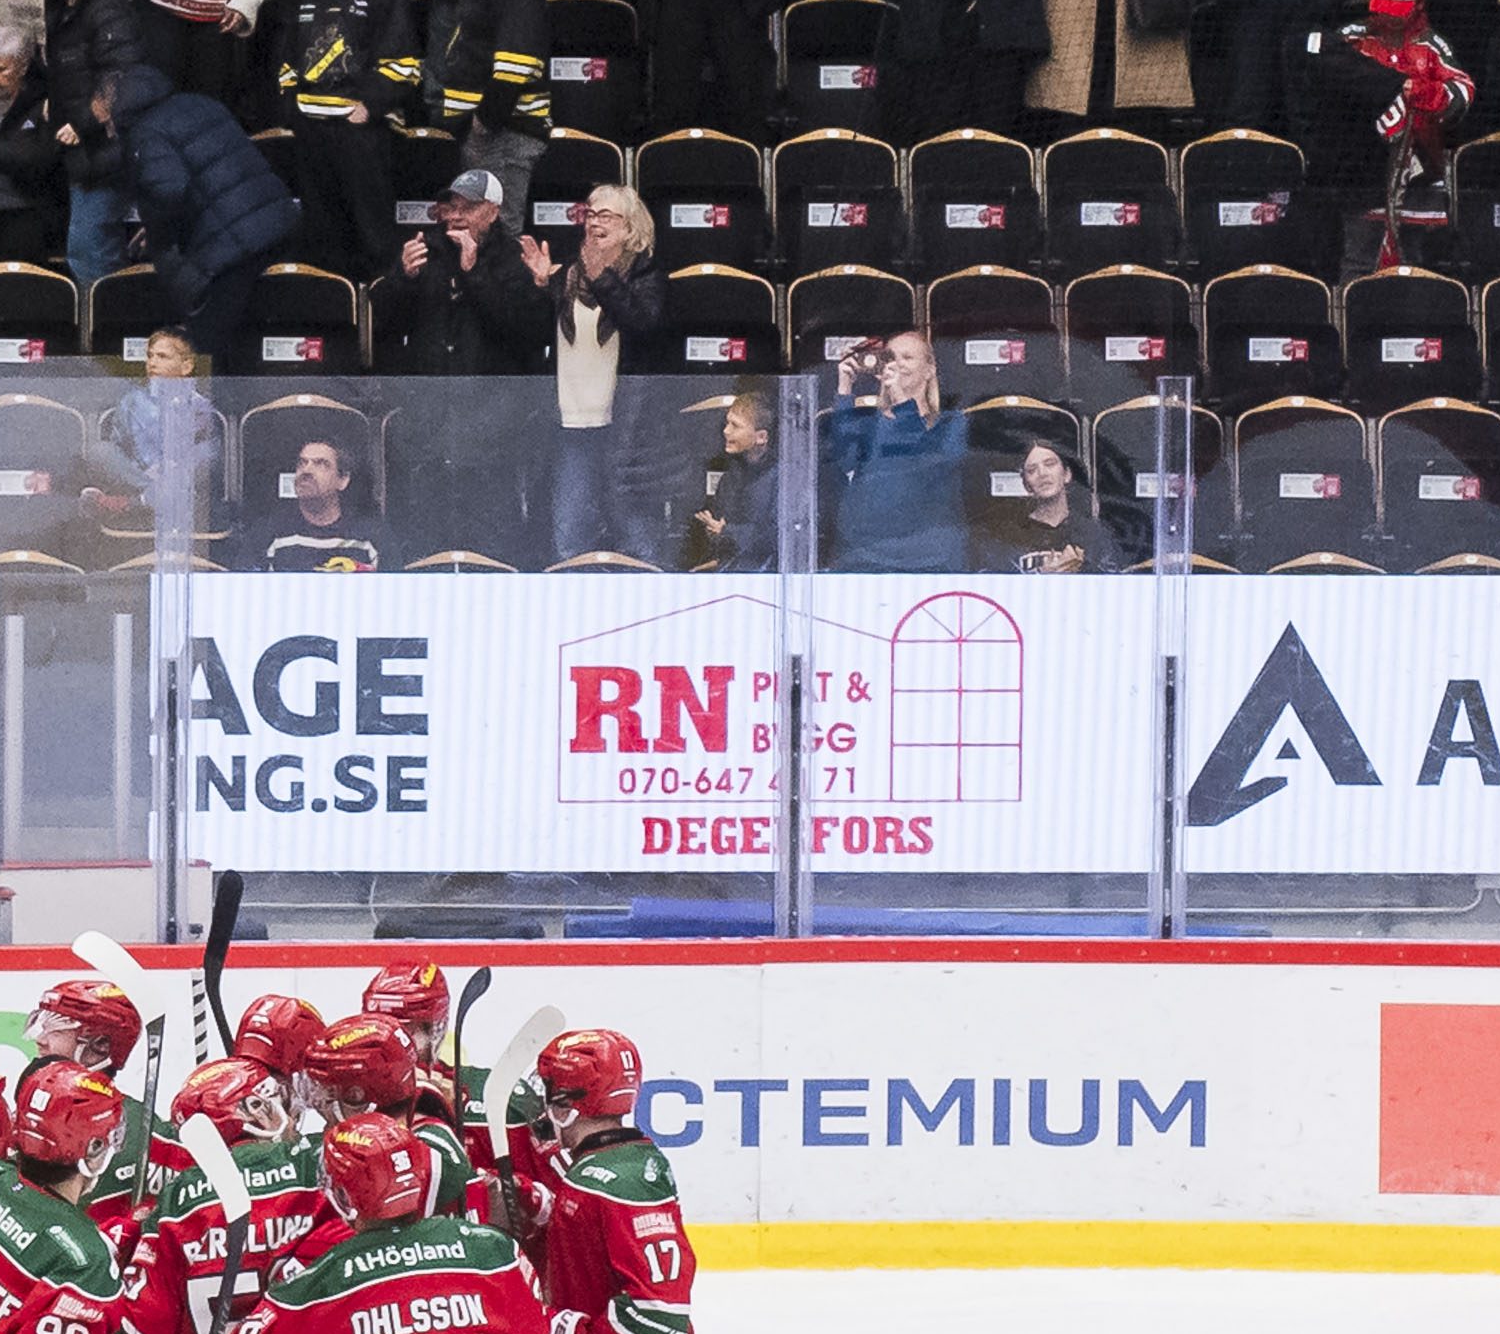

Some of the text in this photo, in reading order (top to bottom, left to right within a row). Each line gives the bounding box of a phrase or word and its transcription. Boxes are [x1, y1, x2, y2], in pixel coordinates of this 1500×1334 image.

[181, 634, 430, 738] AGE
[752, 671, 873, 704] PT &
[569, 665, 735, 754] RN
[752, 722, 859, 753] BGG
[194, 754, 429, 813] NG.SE
[617, 767, 754, 795] 070-647
[642, 815, 936, 856] DEGEFORS
[190, 1164, 298, 1201] Hland
[365, 1240, 467, 1271] Högland
[643, 1239, 682, 1284] 17
